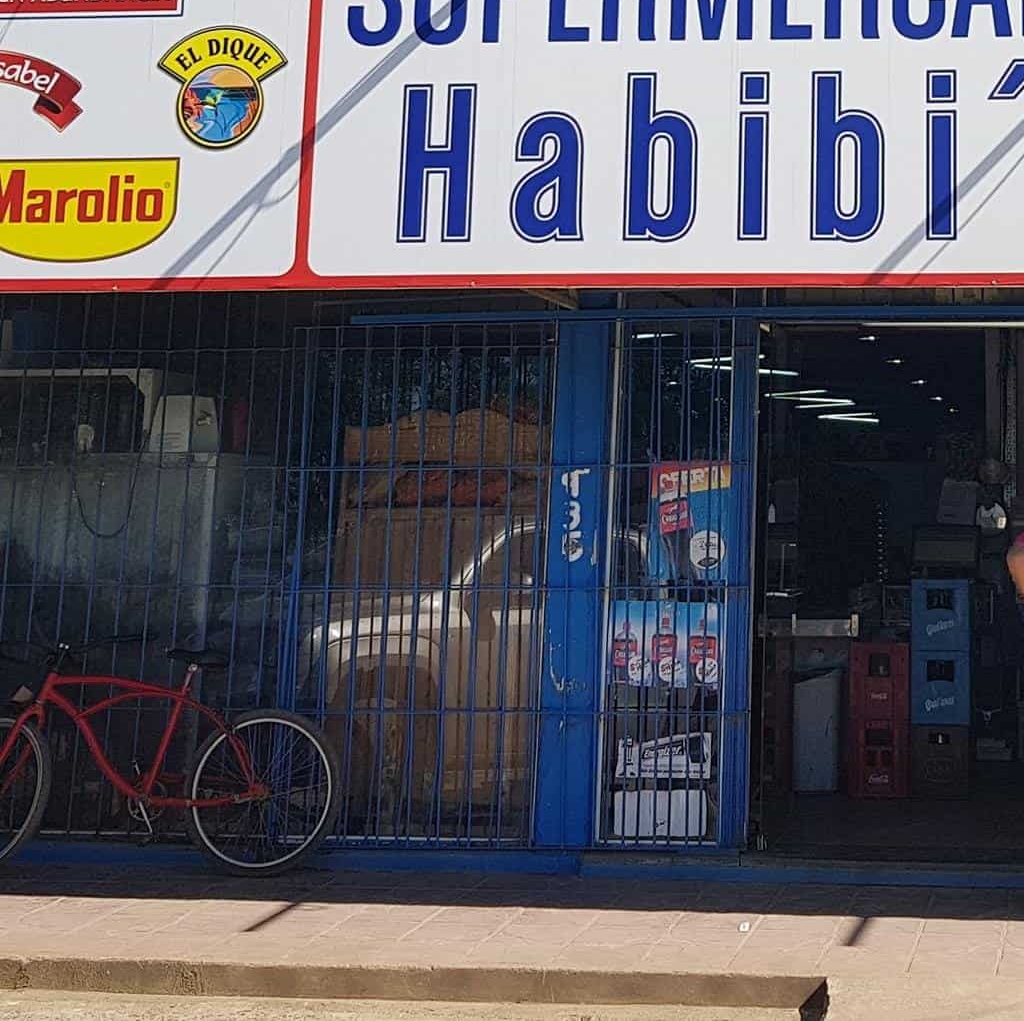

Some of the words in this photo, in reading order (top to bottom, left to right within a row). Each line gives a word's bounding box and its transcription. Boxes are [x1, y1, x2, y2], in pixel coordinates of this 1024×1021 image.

[175, 47, 202, 72] EL
[208, 36, 273, 70] DIQUE
[0, 168, 164, 224] Marolio
